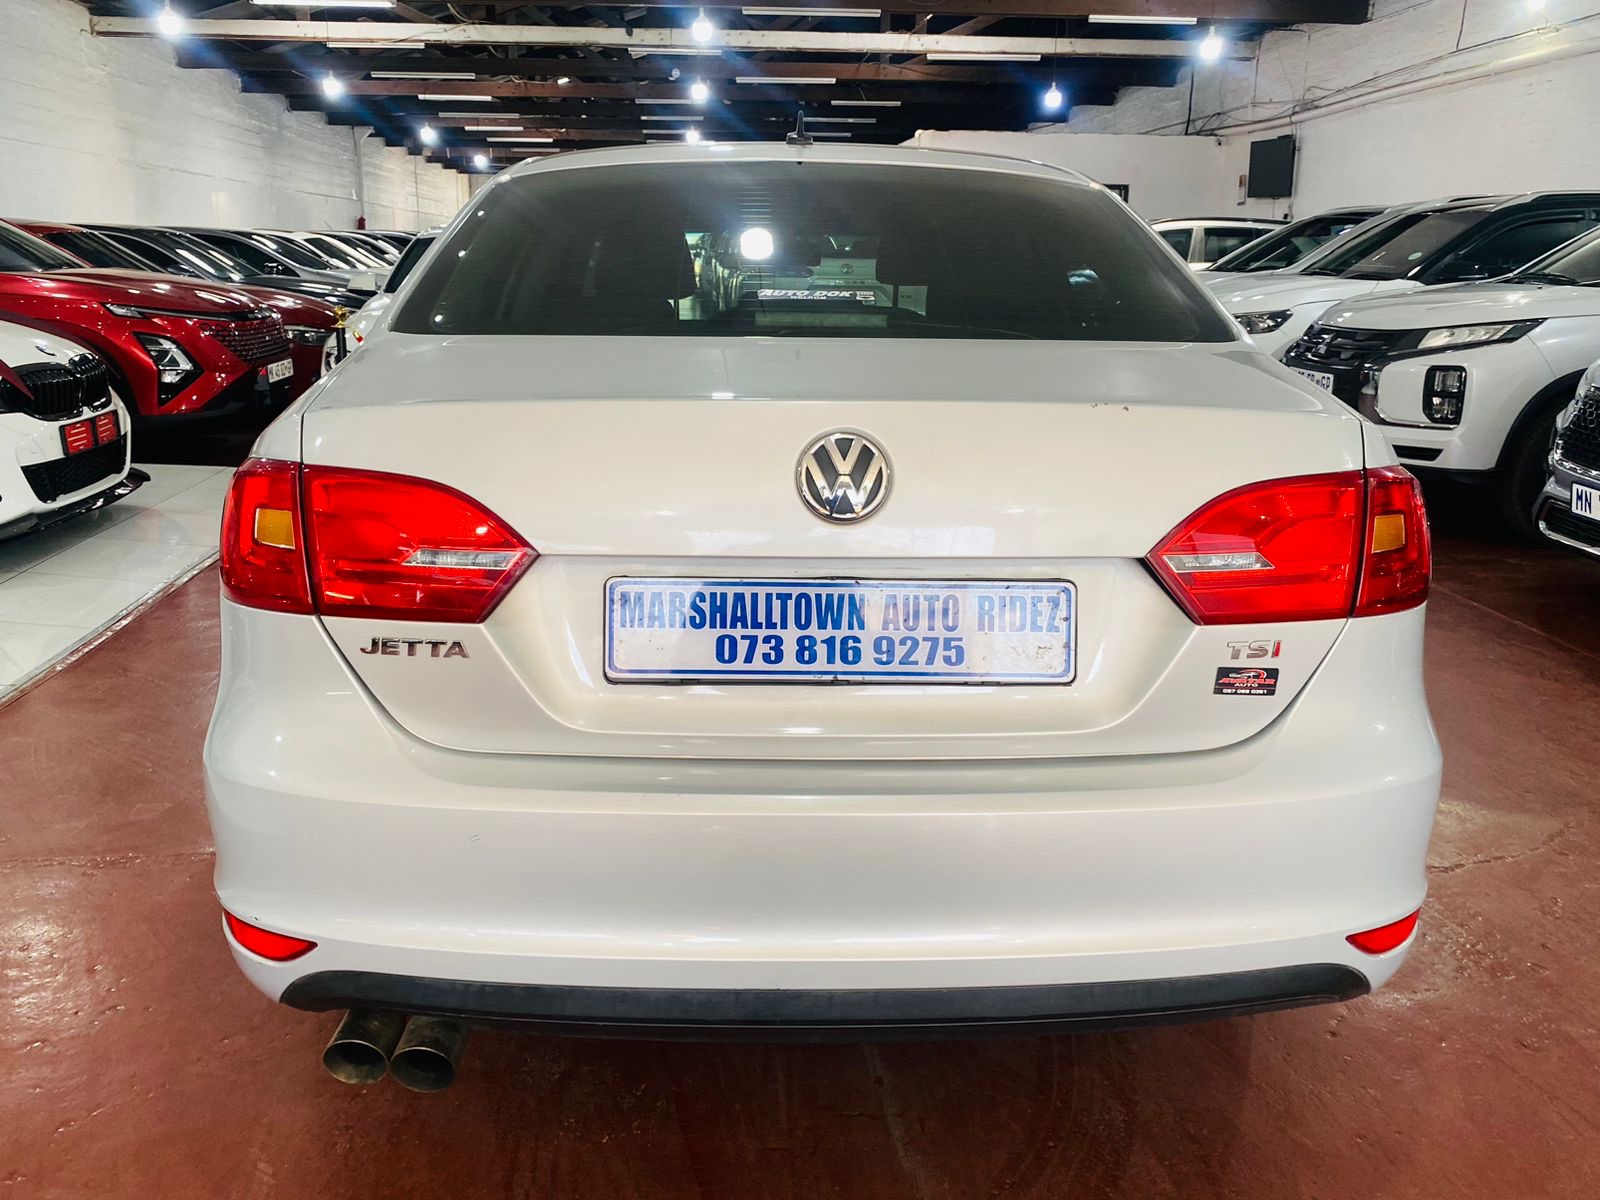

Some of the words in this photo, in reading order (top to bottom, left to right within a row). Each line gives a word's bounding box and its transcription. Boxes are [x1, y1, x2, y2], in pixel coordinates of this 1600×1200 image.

[1575, 487, 1592, 515] MN
[619, 590, 865, 632] MARSHALLTOWN
[881, 593, 960, 632] AUTO
[976, 594, 1061, 634] RIDEZ
[360, 637, 469, 658] JETTA
[715, 633, 785, 665] 073
[794, 635, 863, 666] 816
[872, 636, 966, 668] 9275
[1226, 639, 1282, 660] TSI
